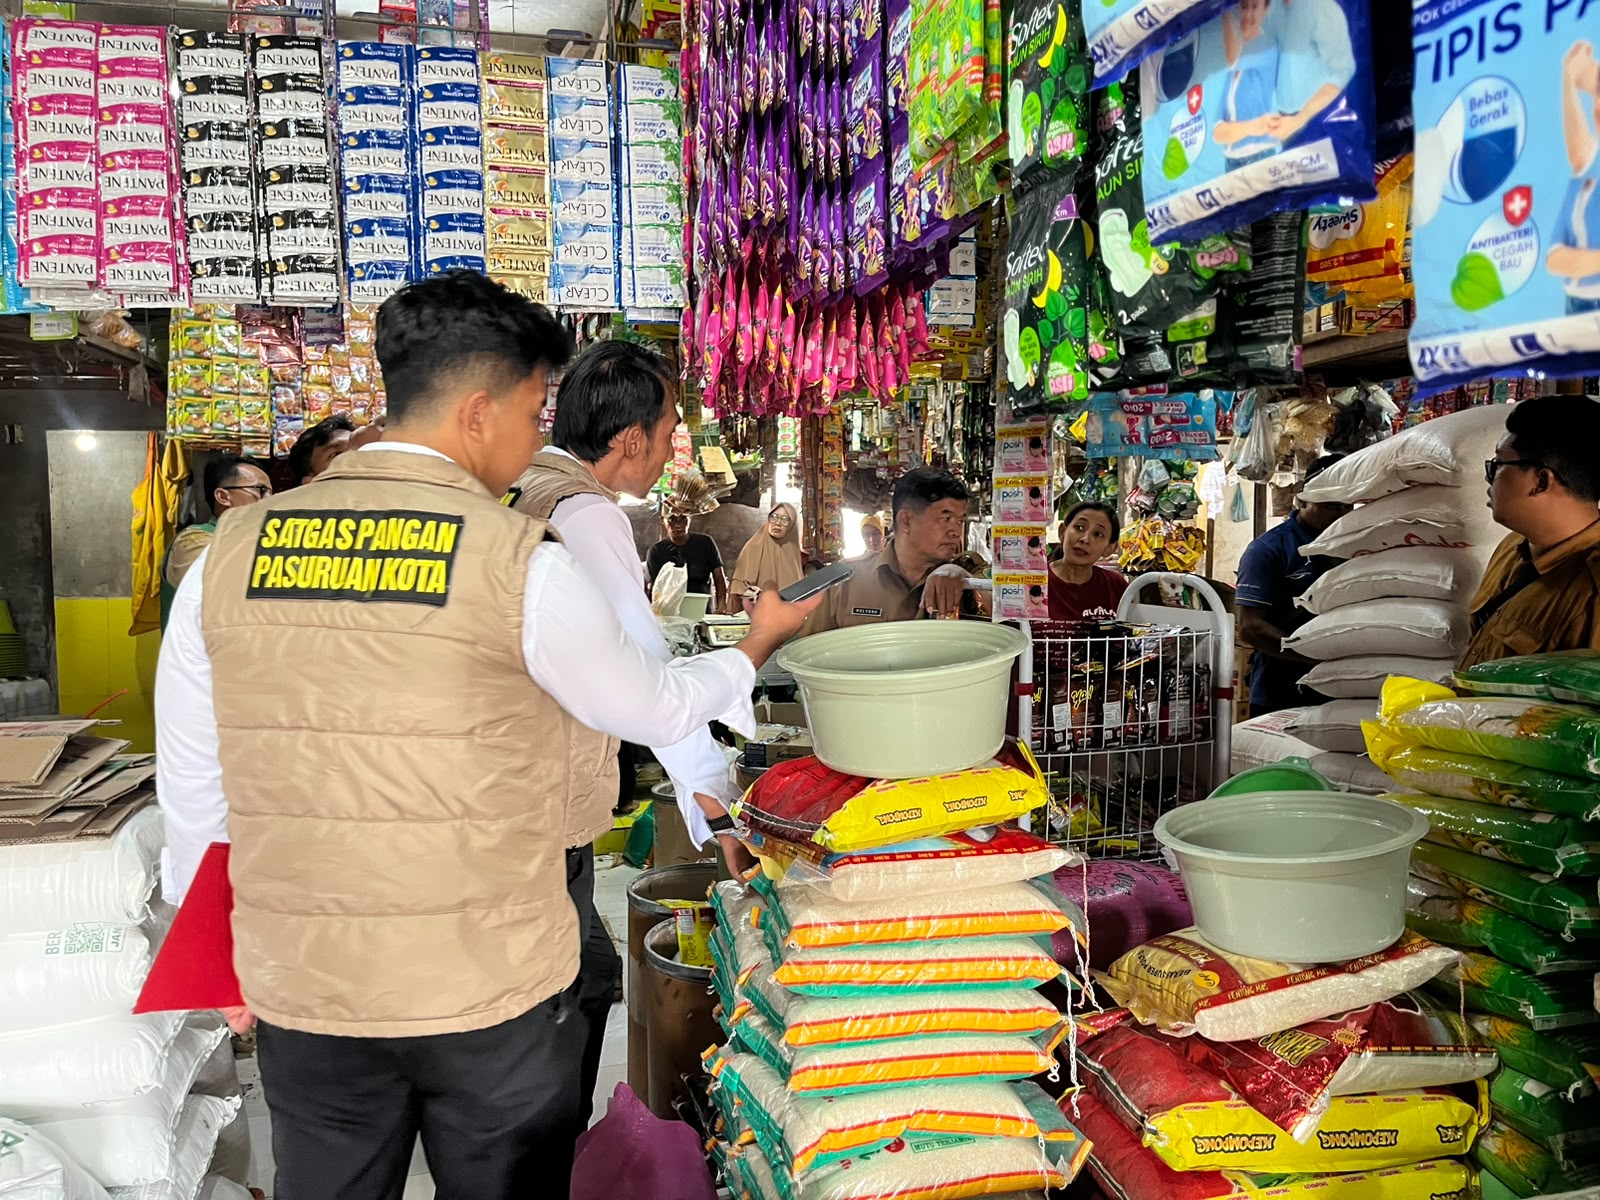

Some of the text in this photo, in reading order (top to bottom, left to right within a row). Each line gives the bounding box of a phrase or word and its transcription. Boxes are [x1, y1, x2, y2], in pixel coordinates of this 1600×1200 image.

[1011, 2, 1056, 56] Softex
[31, 30, 93, 44] PANTENE
[1028, 24, 1052, 56] SIRIH
[99, 39, 158, 52] PANTENE
[183, 55, 240, 68] PANTENE
[260, 54, 315, 66] PANTENE
[343, 65, 397, 80] PANTENE
[421, 64, 474, 78] PANTENE
[30, 73, 92, 88] PANTENE
[558, 77, 601, 92] CLEAR
[262, 98, 319, 111] PANTENE
[1469, 88, 1509, 111] Bebas
[186, 100, 243, 114] PANTENE
[423, 107, 476, 121] PANTENE
[345, 110, 399, 123] PANTENE
[1469, 104, 1509, 128] Gerak
[30, 120, 92, 136] PANTENE
[560, 119, 603, 134] CLEAR
[1180, 123, 1204, 140] CEGAH
[102, 130, 162, 143] PANTENE
[1184, 137, 1197, 149] BAU
[186, 147, 245, 159] PANTENE
[266, 144, 322, 156] PANTENE
[424, 150, 478, 164] PANTENE
[348, 154, 401, 167] PANTENE
[1300, 154, 1321, 168] CM
[32, 168, 92, 182] PANTENE
[561, 160, 605, 176] CLEAR
[104, 176, 164, 189] PANTENE
[1097, 171, 1123, 203] AUN
[427, 194, 480, 208] PANTENE
[491, 190, 546, 204] PANTENE
[350, 199, 403, 211] PANTENE
[563, 202, 606, 218] CLEAR
[32, 214, 92, 228] PANTENE
[1312, 209, 1359, 232] Sweety
[106, 223, 167, 235] PANTENE
[430, 237, 481, 250] PANTENE
[491, 233, 546, 246] PANTENE
[1471, 226, 1534, 251] ANTIBAKTERI
[352, 242, 405, 254] PANTENE
[564, 245, 607, 260] CLEAR
[1493, 240, 1534, 259] CEGAH
[32, 261, 93, 275] PANTENE
[490, 258, 545, 272] PANTENE
[1500, 257, 1522, 271] BAU
[109, 269, 169, 281] PANTENE
[1022, 267, 1044, 289] SIRIH
[566, 287, 608, 301] CLEAR
[1118, 310, 1131, 326] 2
[1003, 440, 1024, 454] posh
[1002, 487, 1023, 502] posh
[261, 517, 458, 553] SATGAS PANGAN
[1002, 537, 1022, 551] posh
[251, 555, 446, 593] PASURUAN KOTA
[1002, 585, 1024, 599] posh
[45, 931, 62, 955] BER
[111, 927, 122, 948] JAN
[1147, 965, 1166, 978] SUPER
[914, 1142, 936, 1150] MUTU
[1192, 1133, 1277, 1154] KEPOMPONG
[1317, 1129, 1399, 1150] KEPOMPONG
